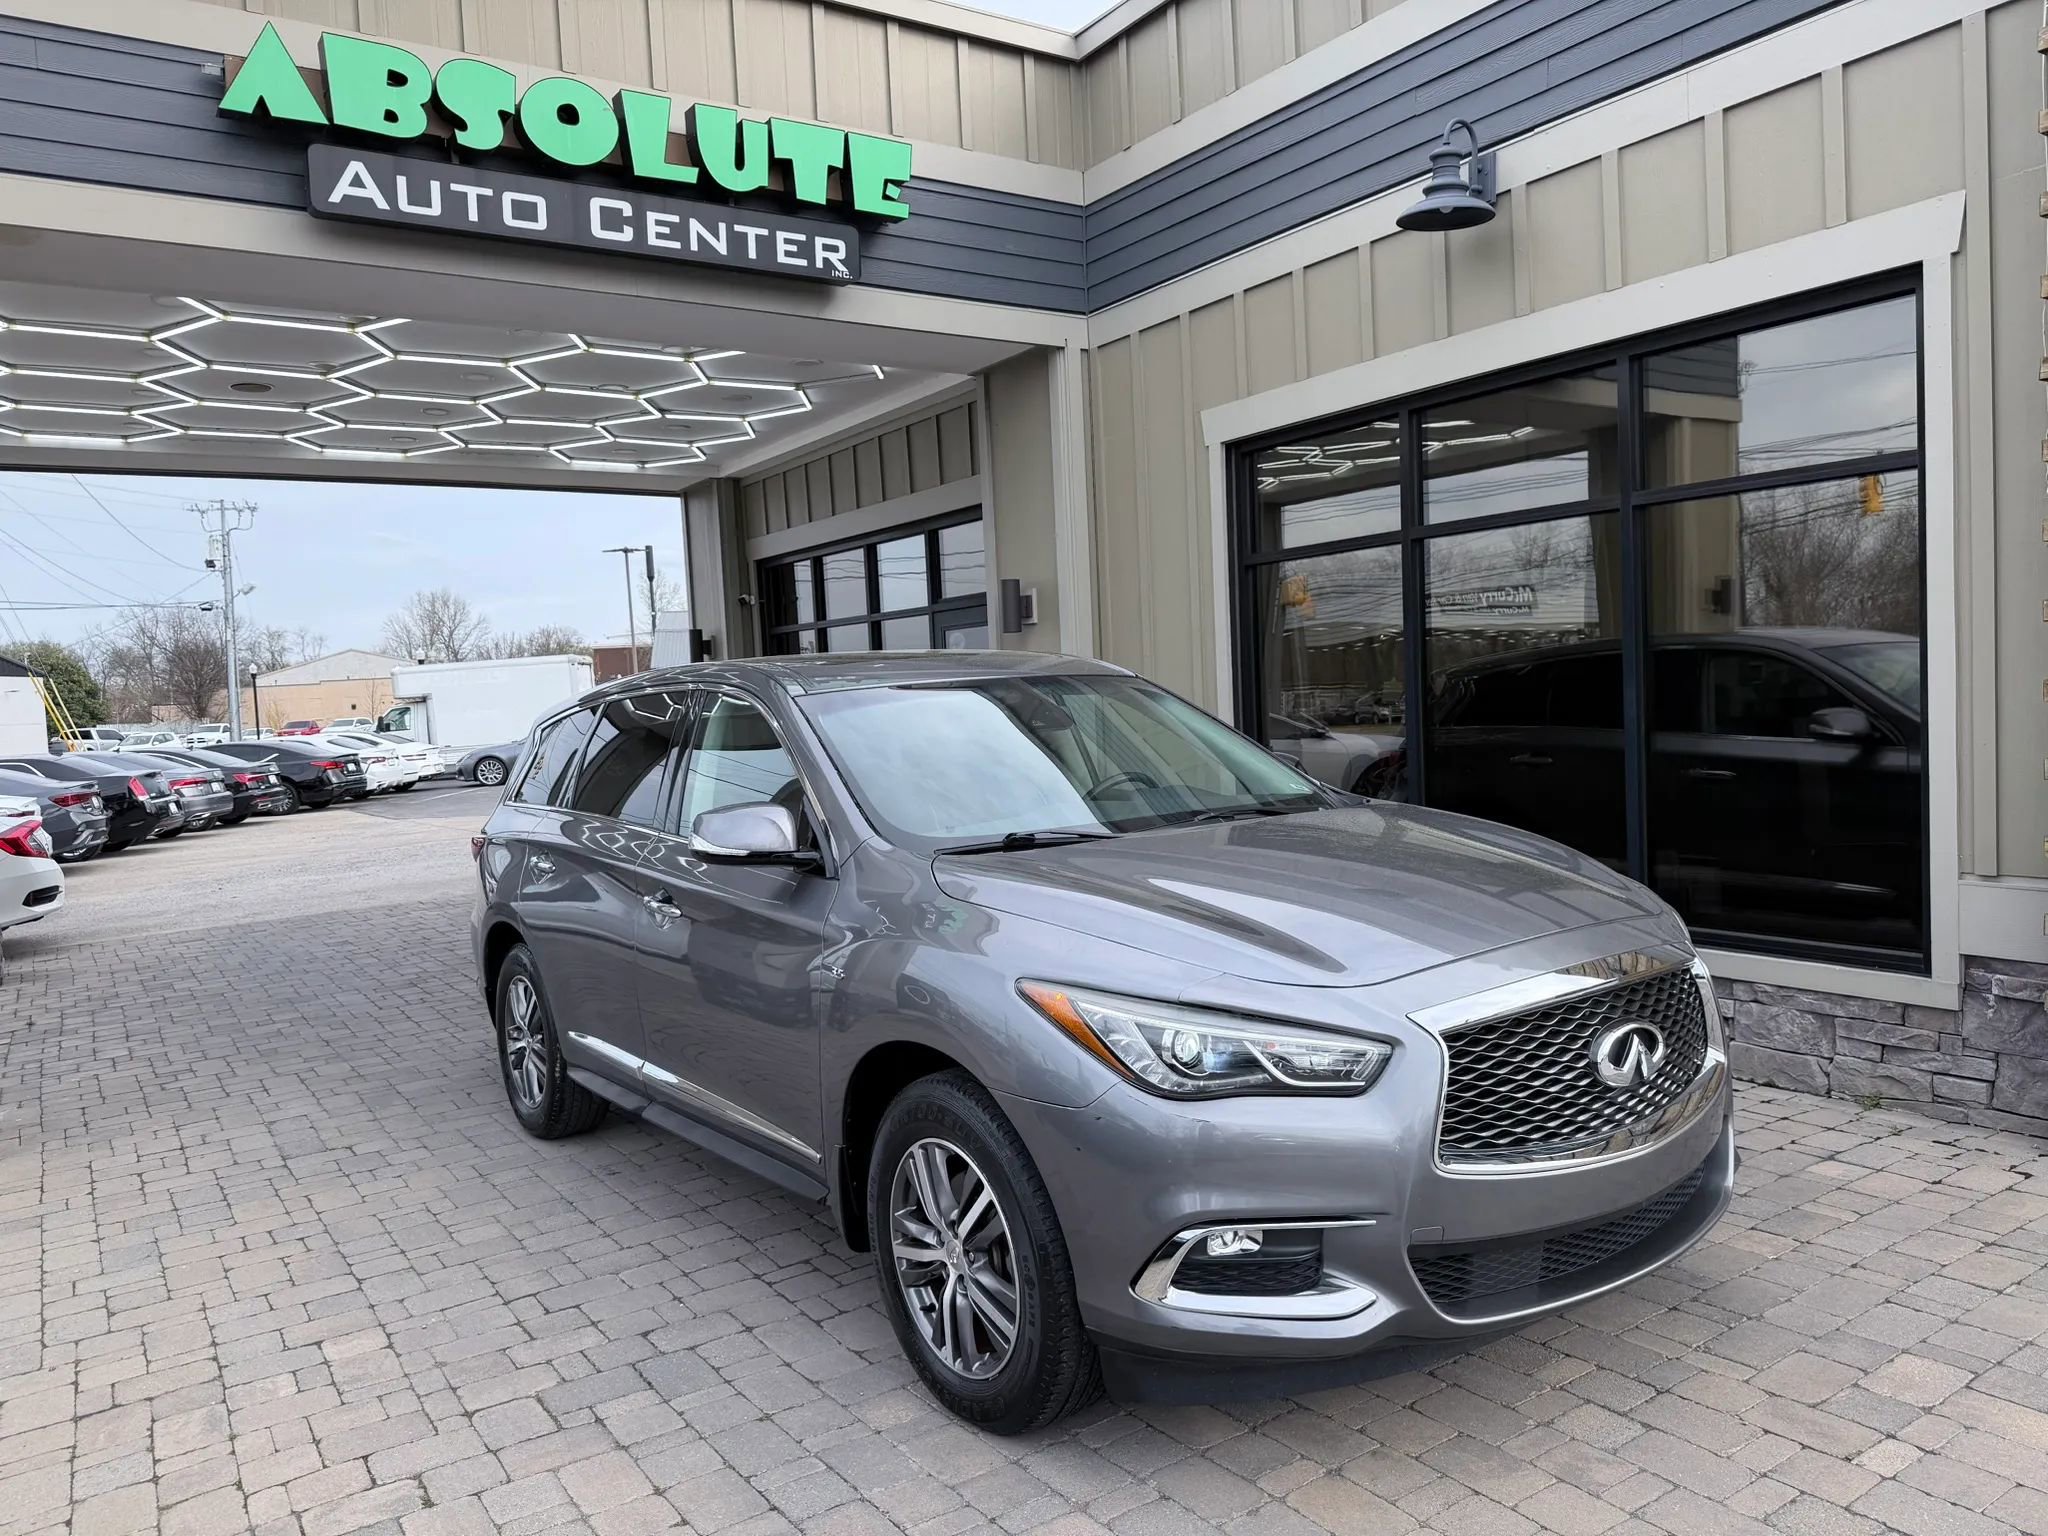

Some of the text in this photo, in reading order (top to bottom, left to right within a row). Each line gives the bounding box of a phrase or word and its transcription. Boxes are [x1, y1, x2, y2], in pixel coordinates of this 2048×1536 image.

[218, 20, 912, 221] ABSOLUTE
[327, 160, 849, 272] AUTO CENTER
[831, 269, 853, 279] INC.
